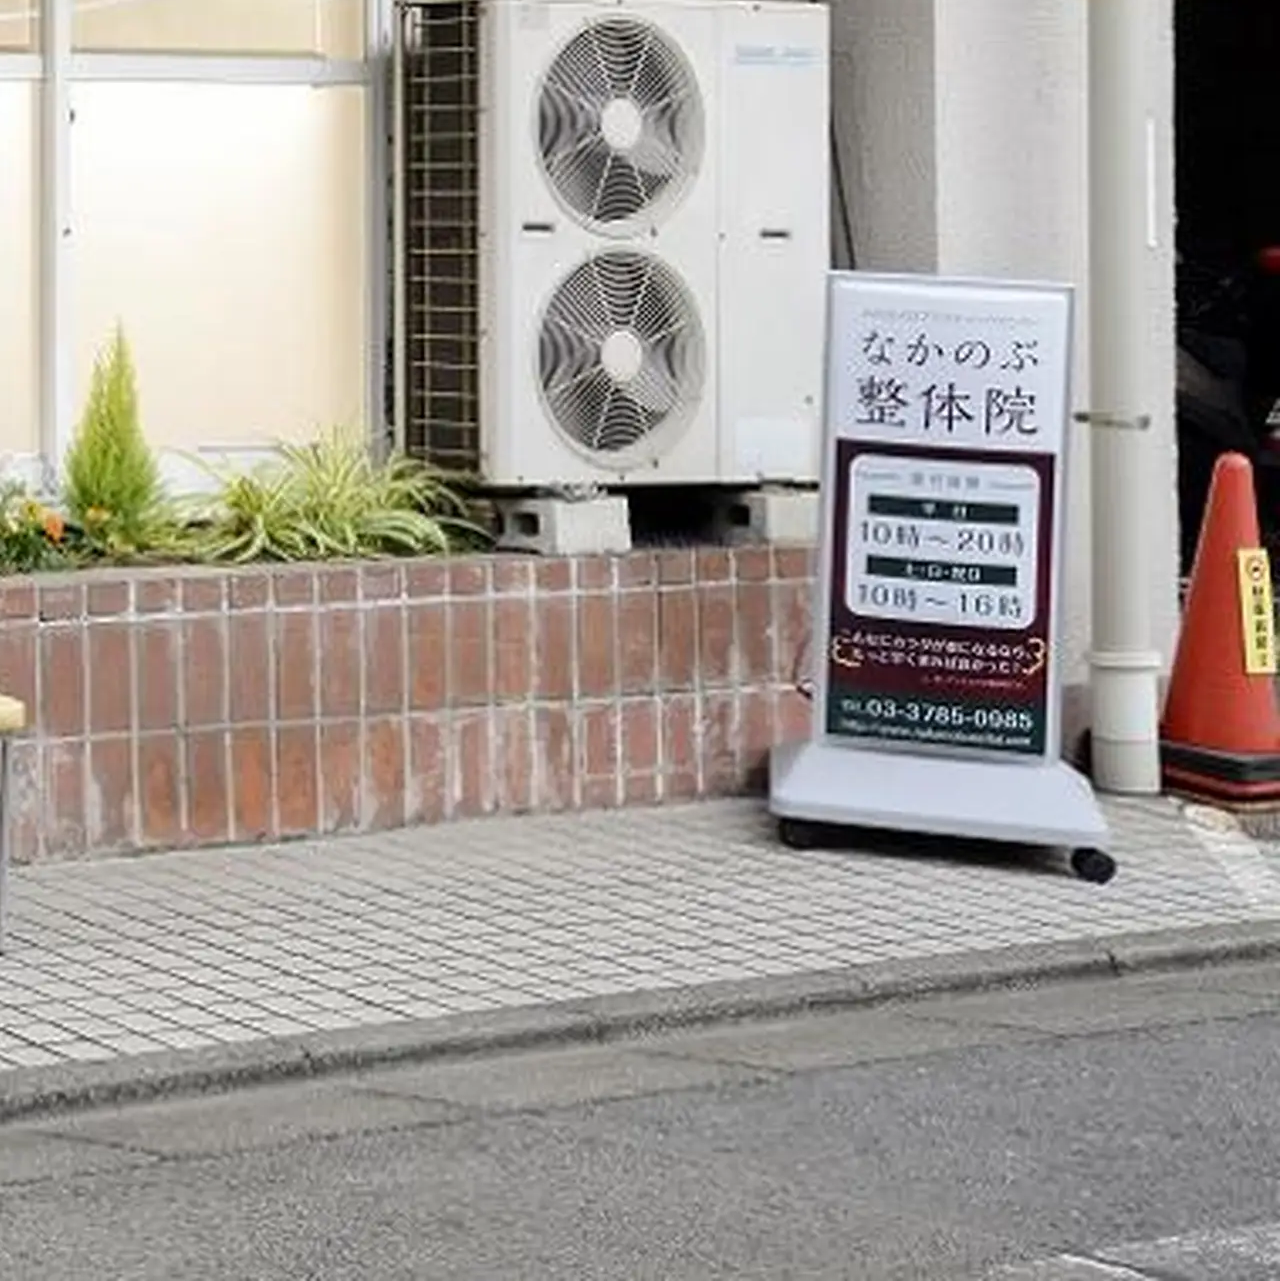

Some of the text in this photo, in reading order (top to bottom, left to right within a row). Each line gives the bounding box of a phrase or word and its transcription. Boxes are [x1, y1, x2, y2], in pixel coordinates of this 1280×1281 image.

[862, 331, 1040, 373] なかのぶ
[855, 374, 1040, 436] 整体院
[865, 698, 1034, 731] 03-3785-0985
